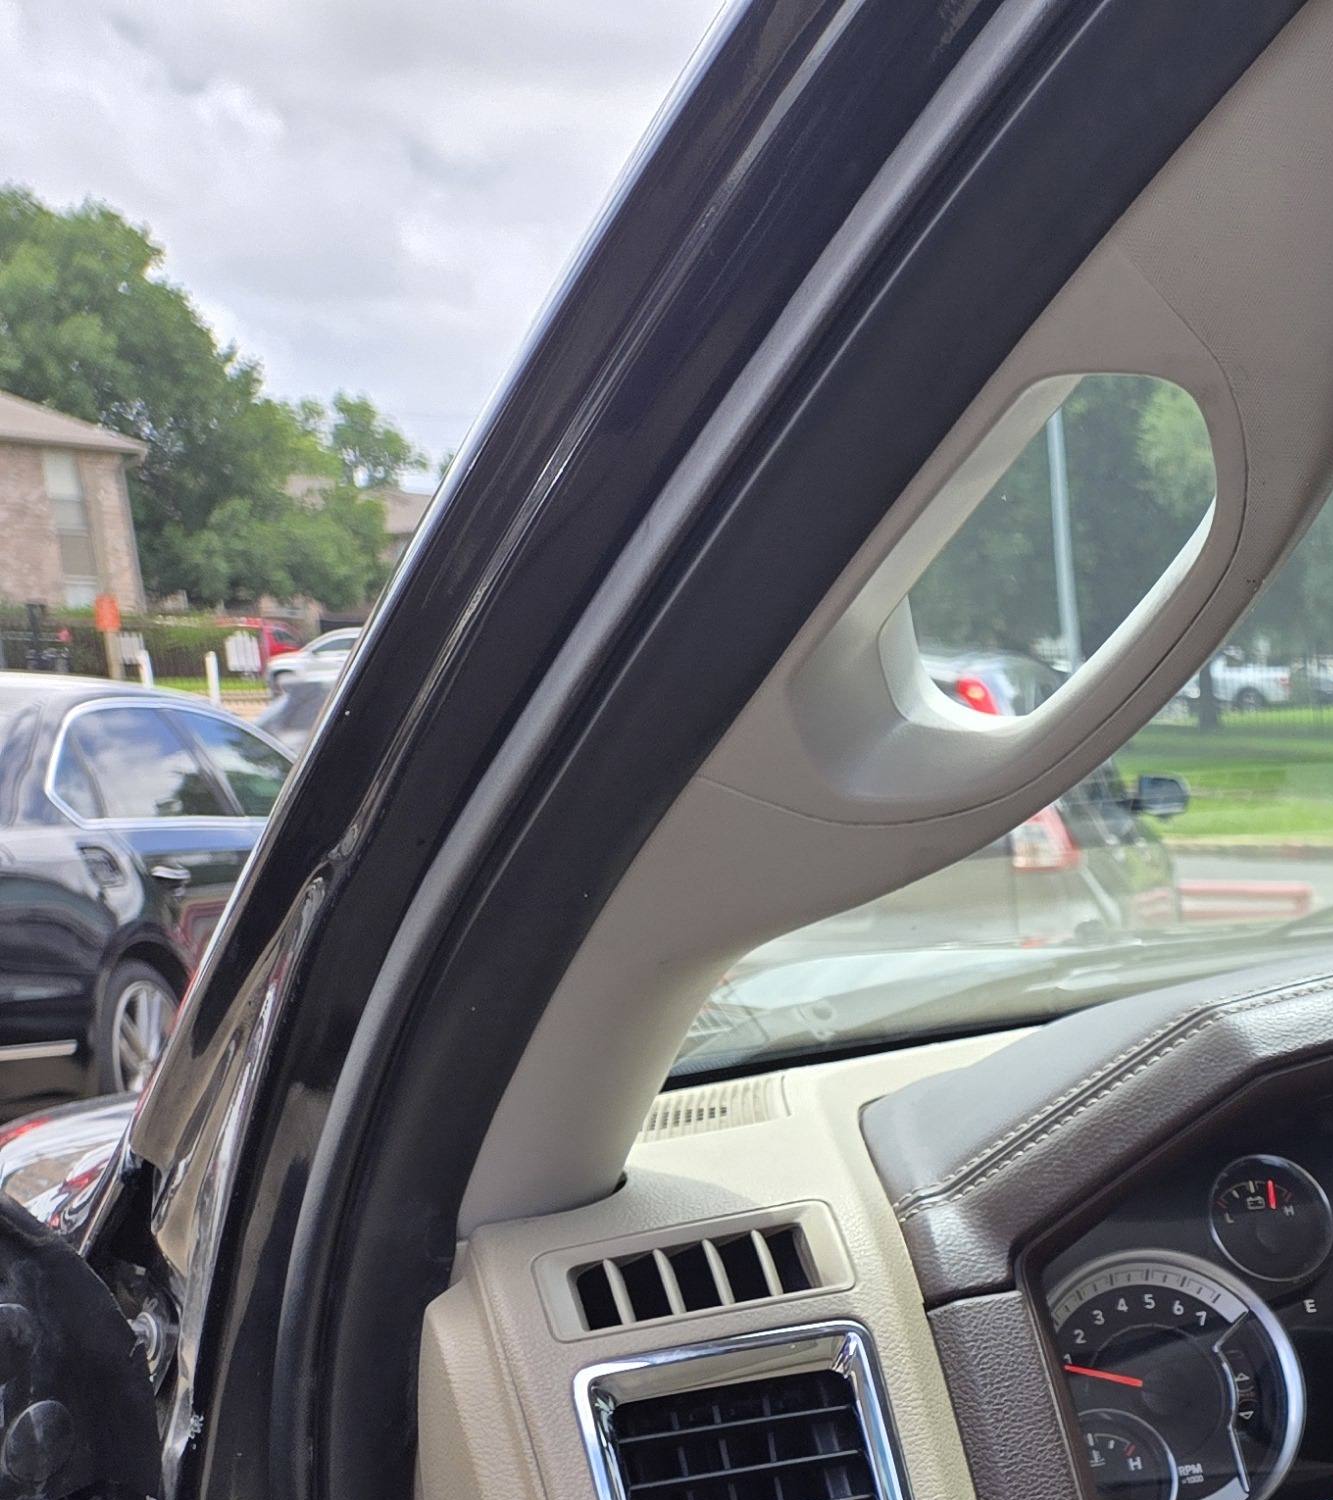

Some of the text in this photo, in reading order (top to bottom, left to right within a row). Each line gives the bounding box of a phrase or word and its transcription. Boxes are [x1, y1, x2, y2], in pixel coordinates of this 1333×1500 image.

[1117, 1298, 1128, 1312] 4
[1144, 1294, 1156, 1309] 5
[1173, 1300, 1184, 1316] 6
[1304, 1299, 1317, 1314] E
[1092, 1310, 1105, 1325] 3
[1195, 1311, 1207, 1326] 7
[1073, 1329, 1087, 1344] 2
[1127, 1456, 1142, 1471] H
[1178, 1463, 1203, 1478] RPM
